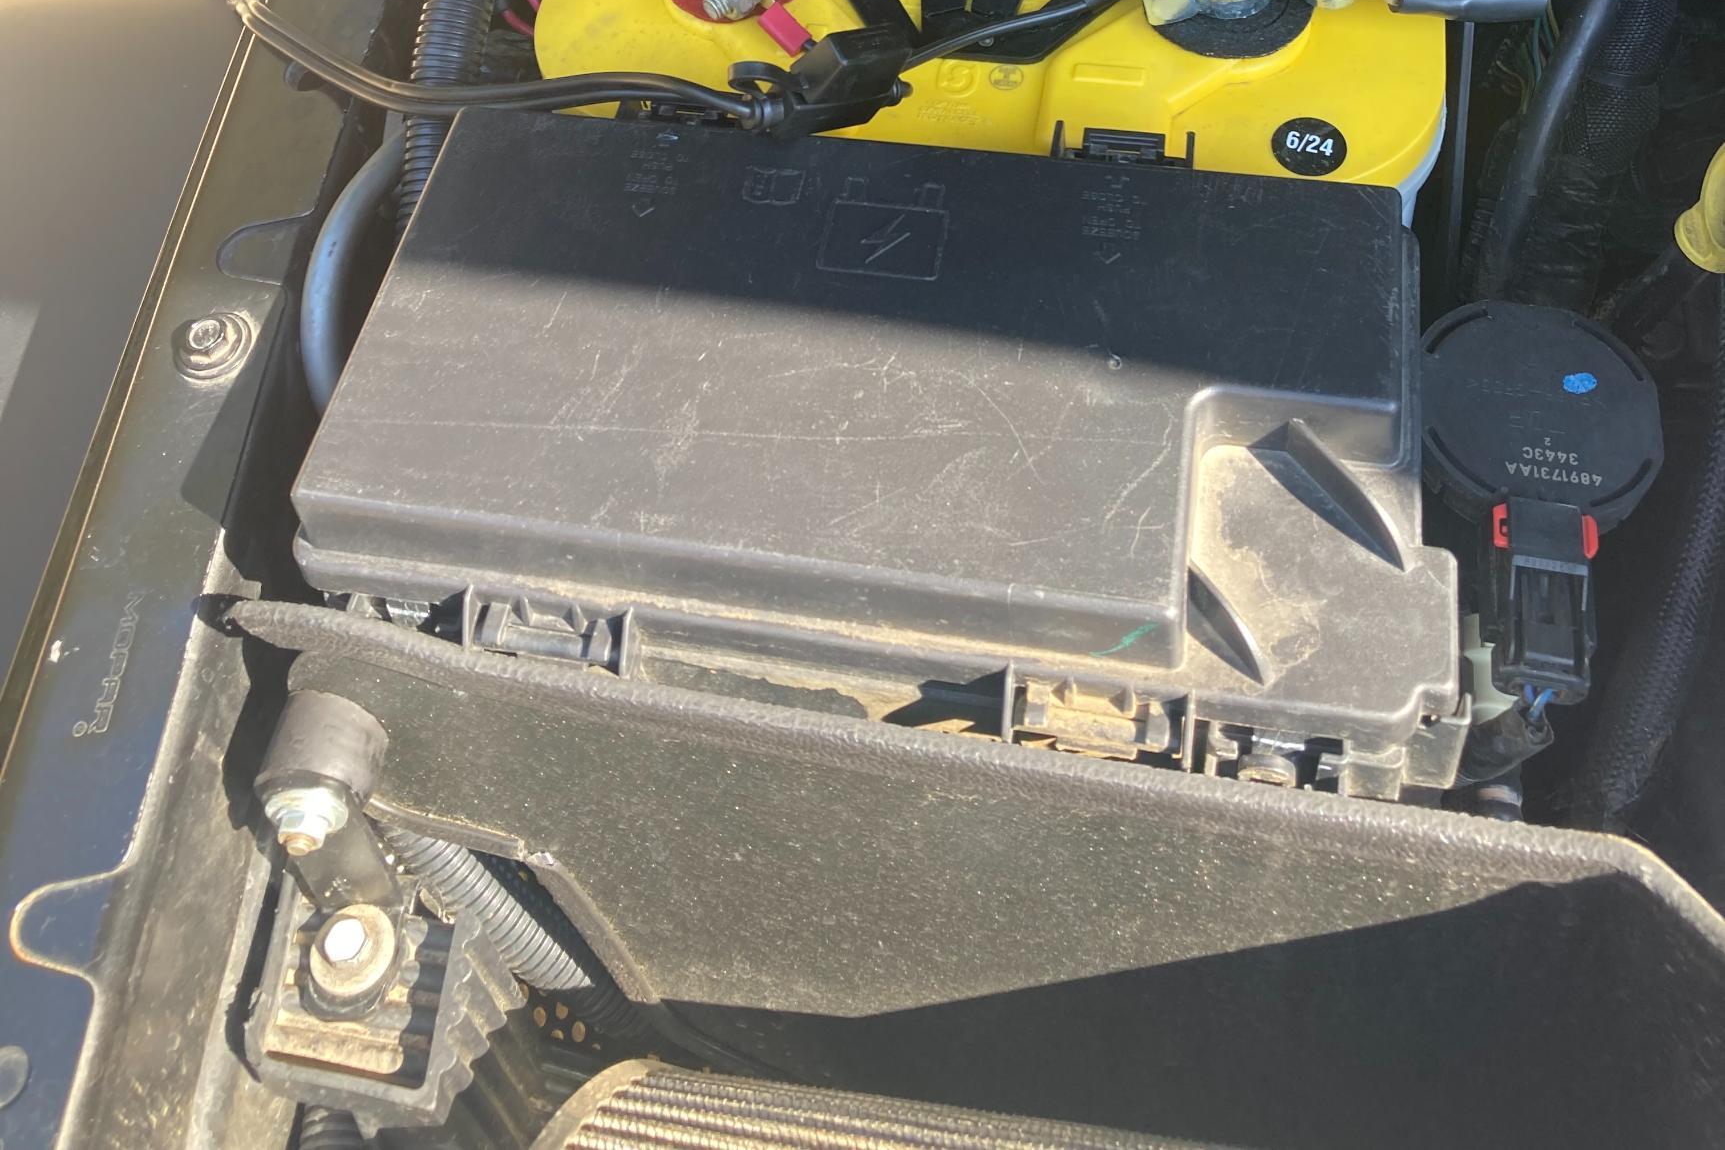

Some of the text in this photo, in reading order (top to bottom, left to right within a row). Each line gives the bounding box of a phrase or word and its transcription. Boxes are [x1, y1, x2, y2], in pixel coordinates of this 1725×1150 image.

[1285, 130, 1334, 157] 6/24
[1543, 436, 1552, 446] 2
[1521, 446, 1579, 466] 3443C
[1504, 460, 1603, 487] 4891731AA
